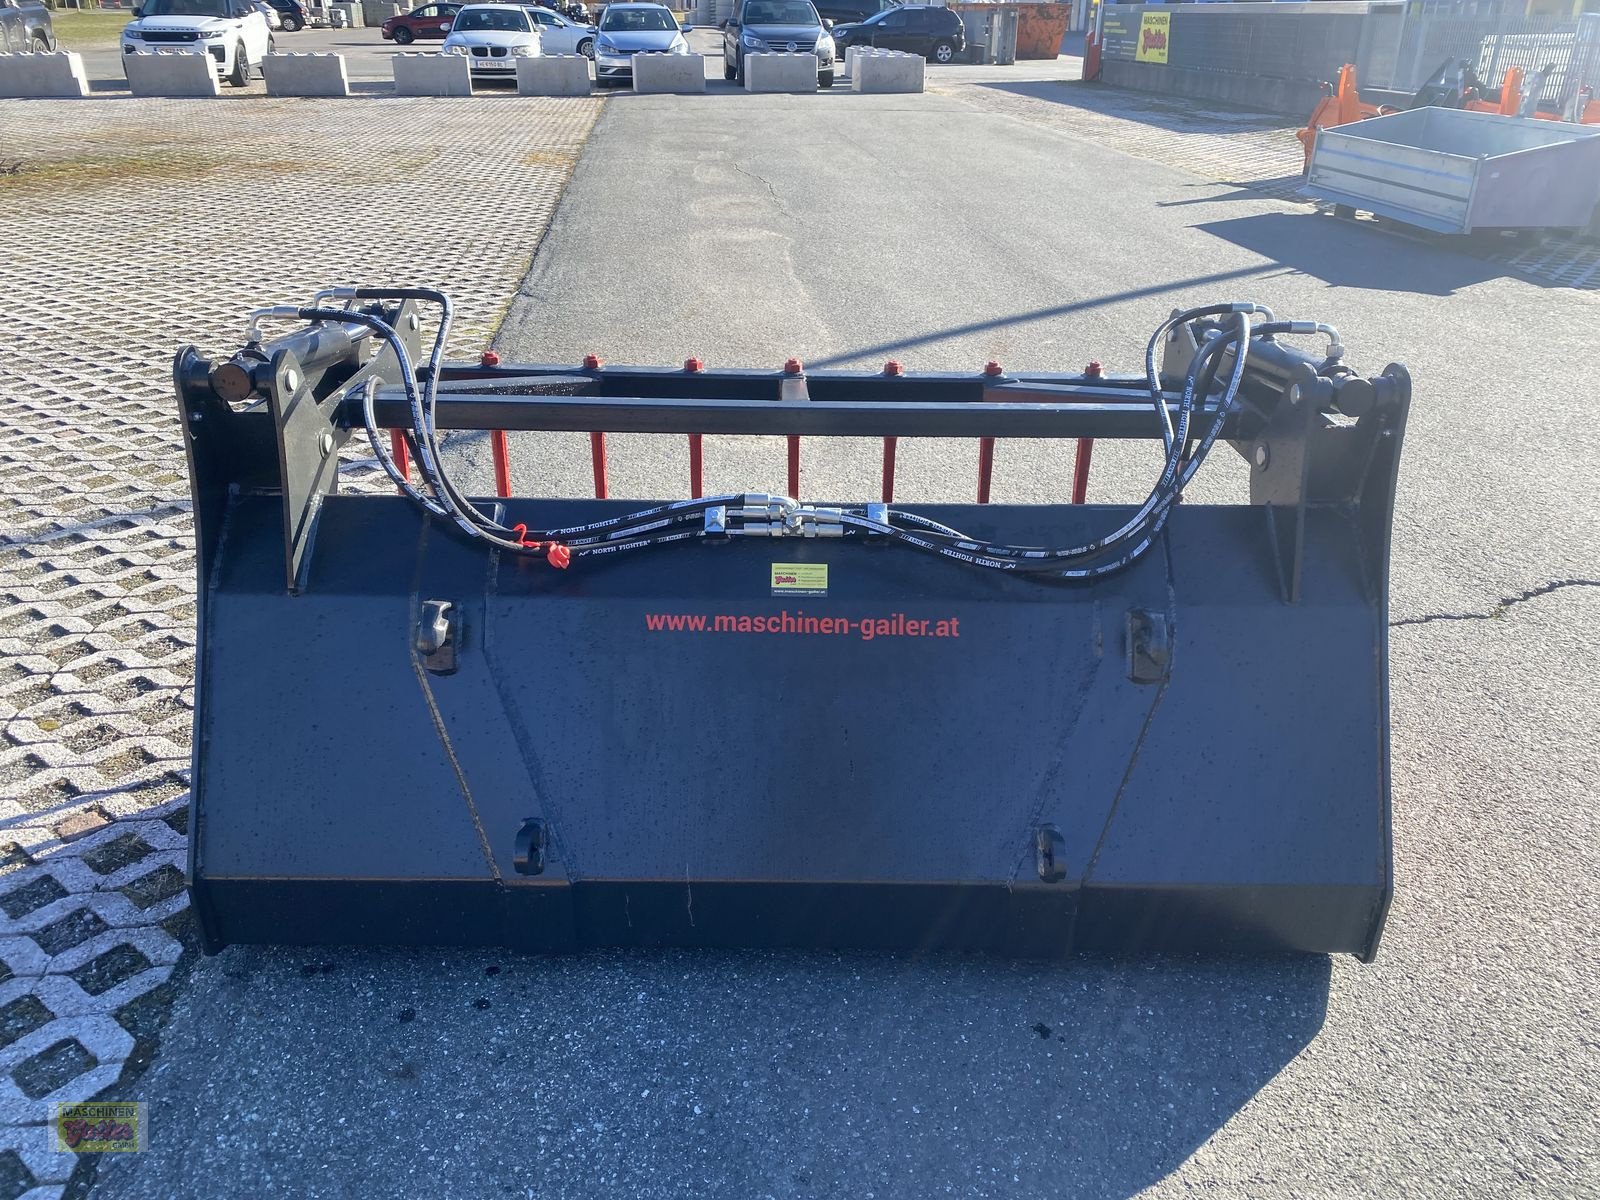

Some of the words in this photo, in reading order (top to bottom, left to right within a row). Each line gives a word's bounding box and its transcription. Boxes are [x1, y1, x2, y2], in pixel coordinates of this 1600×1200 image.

[1183, 385, 1193, 408] NORTH
[560, 525, 586, 535] NORTH
[592, 545, 617, 555] NORTH
[975, 557, 1002, 569] NORTH
[645, 610, 961, 641] www.maschinen-gailer.at
